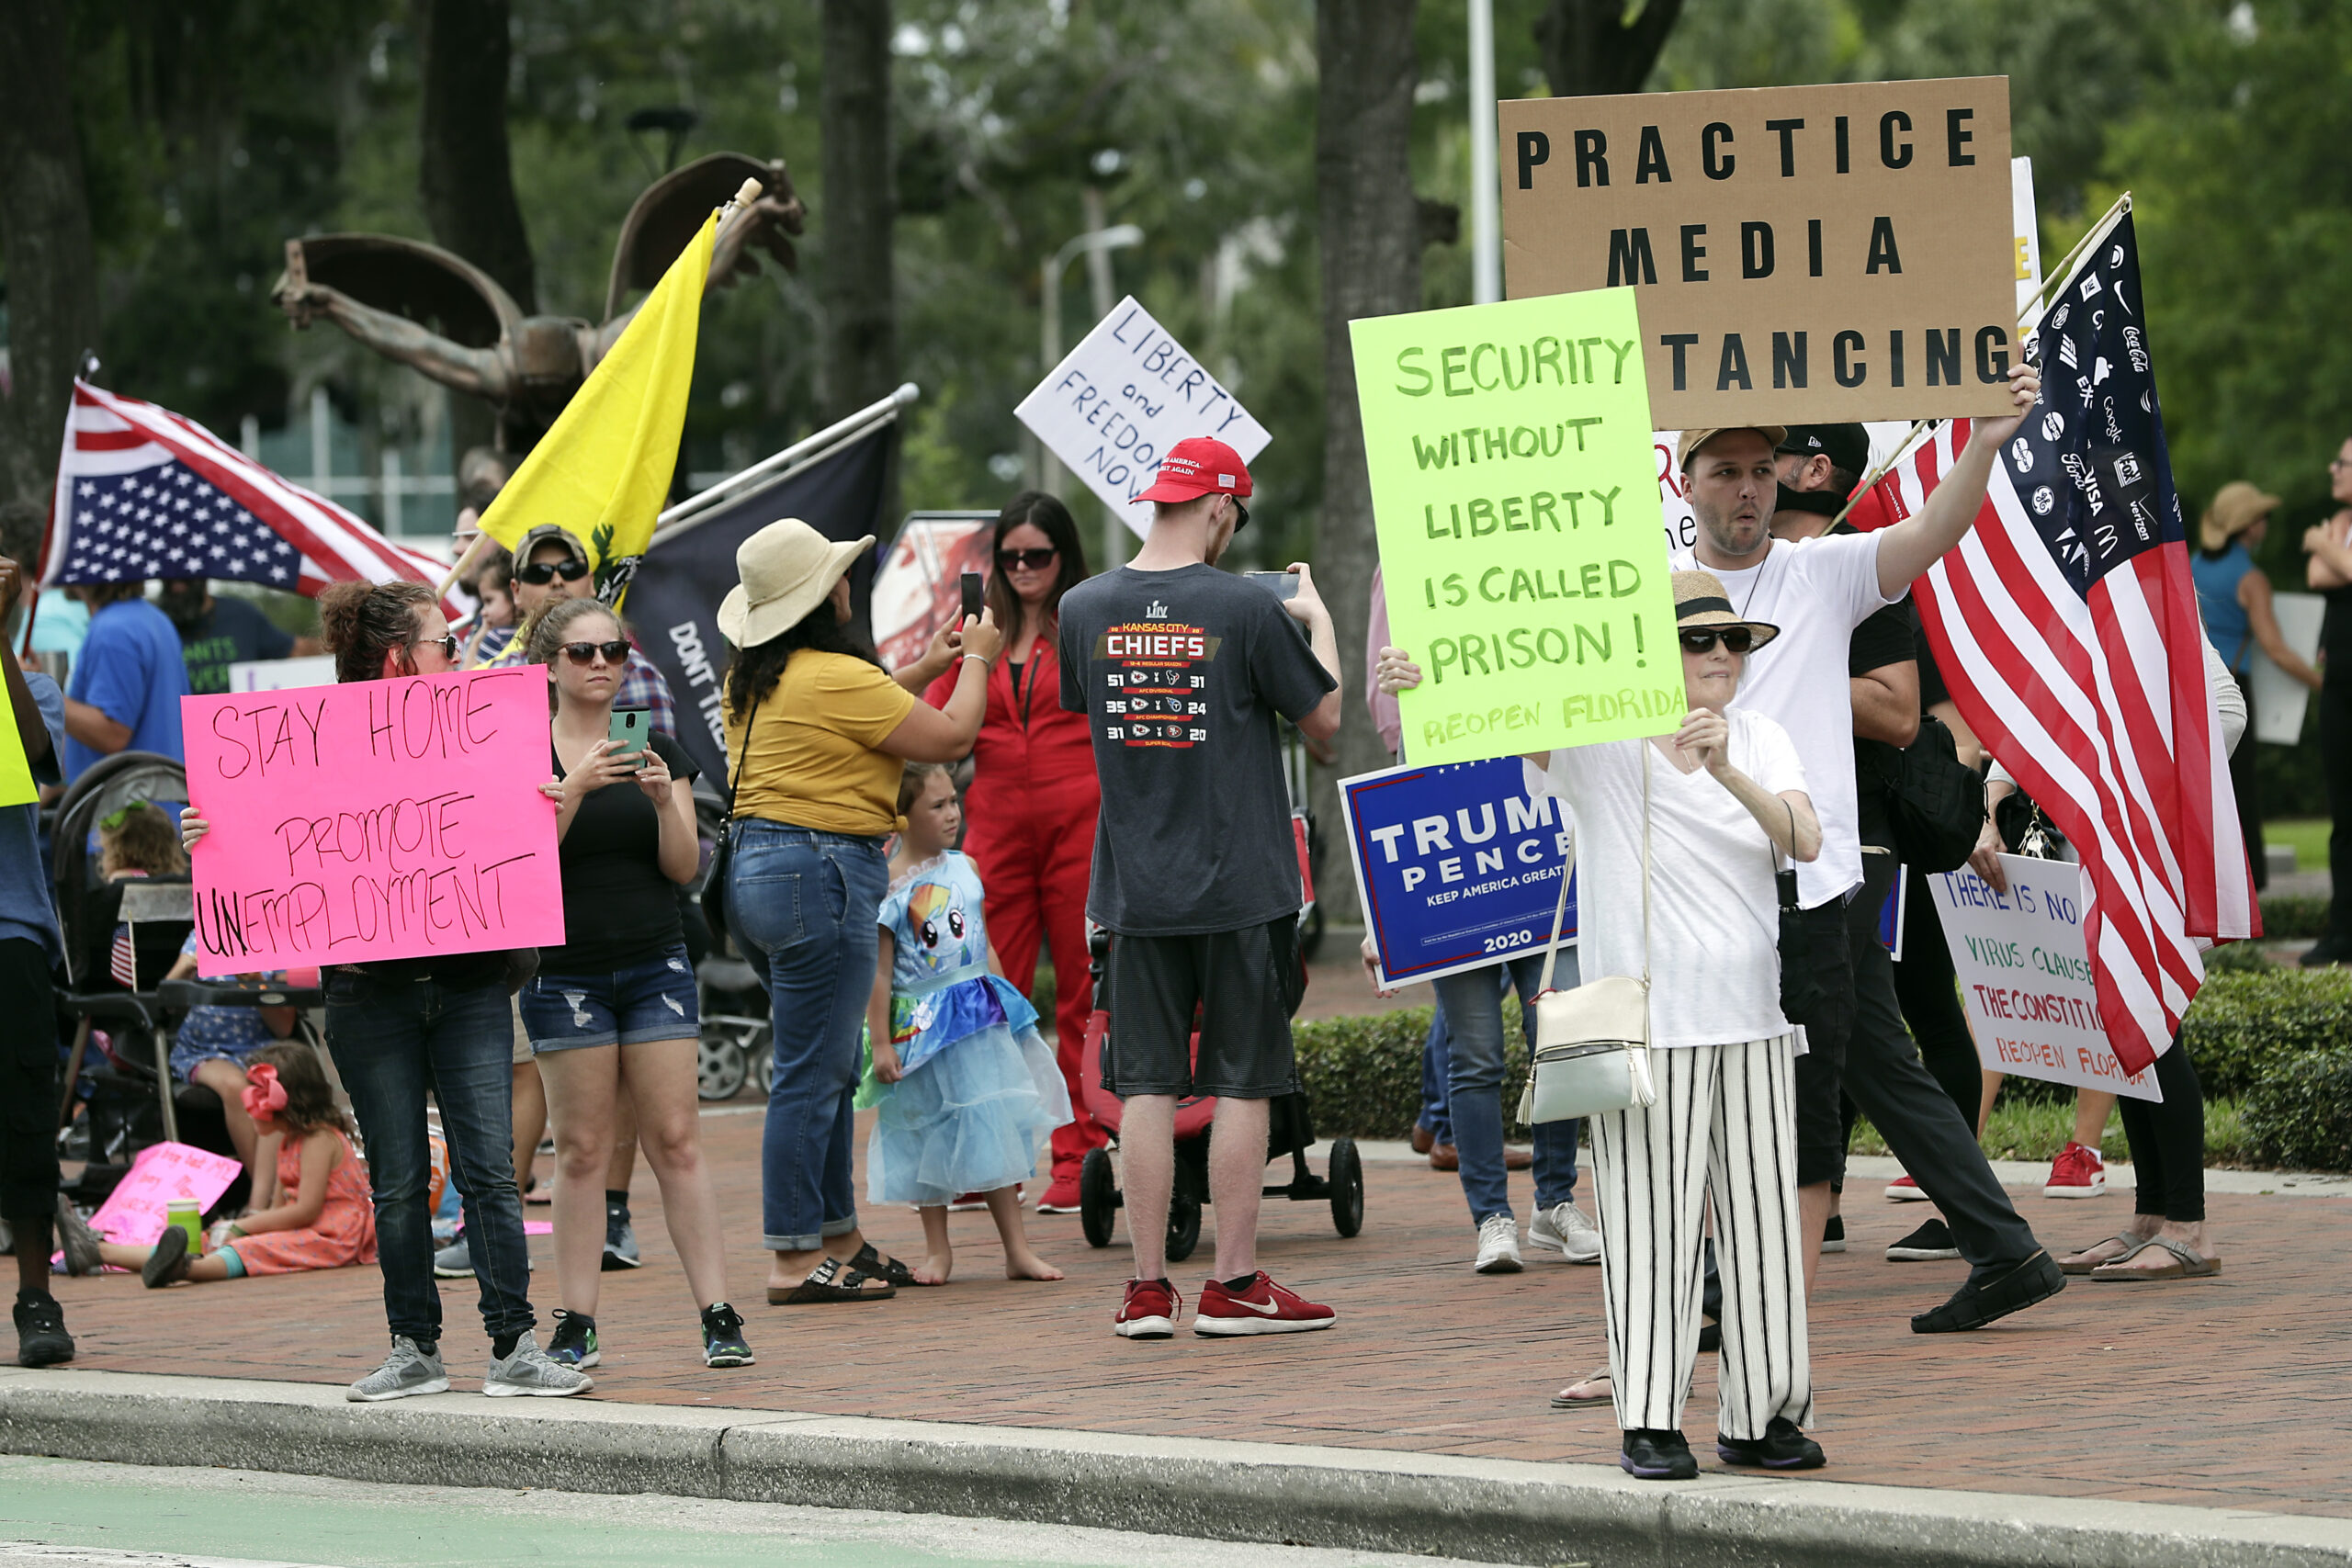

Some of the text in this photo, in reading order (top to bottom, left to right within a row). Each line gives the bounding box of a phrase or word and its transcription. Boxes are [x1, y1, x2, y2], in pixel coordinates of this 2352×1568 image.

[1517, 107, 1974, 189] PRACTICE
[1607, 216, 1902, 287] MEDIA
[1113, 309, 1243, 433] LIBERTY
[1396, 336, 1635, 397] SECURITY
[1660, 324, 2010, 391] TANCING
[1123, 384, 1164, 418] and
[2045, 412, 2062, 442] PEPSI
[2104, 395, 2122, 445] Google
[1168, 457, 1201, 468] AMERICA
[1412, 417, 1602, 469] WITHOUT
[1171, 466, 1194, 476] AGAIN
[2084, 465, 2104, 517] VISA
[1425, 486, 1622, 539] LIBERTY
[2130, 501, 2151, 542] verizon
[1425, 559, 1641, 610] IS CALLED
[1107, 635, 1204, 659] CHIEFS
[1123, 623, 1165, 632] KANSAS
[1166, 623, 1191, 633] CITY
[1430, 622, 1613, 684] PRISON
[1107, 674, 1124, 686] 51
[1190, 675, 1204, 688] 31
[213, 673, 524, 779] STAY HOME
[1106, 700, 1126, 713] 35
[1188, 702, 1206, 715] 24
[1423, 686, 1687, 748] REOPEN FLORIDA
[1107, 727, 1125, 739] 31
[1189, 728, 1206, 741] 20
[275, 791, 475, 877] PROMOTE
[1370, 795, 1554, 863] TRUM
[197, 852, 536, 957] UNEMPLOYMENT
[1427, 890, 1459, 908] KEEP
[1463, 877, 1520, 899] AMERICA
[1943, 871, 2076, 925] THERE IS NO
[1484, 930, 1532, 953] 2020
[1964, 933, 2095, 987] VIRUS CLAUSE
[1996, 1036, 2148, 1088] REOPEN FLORA
